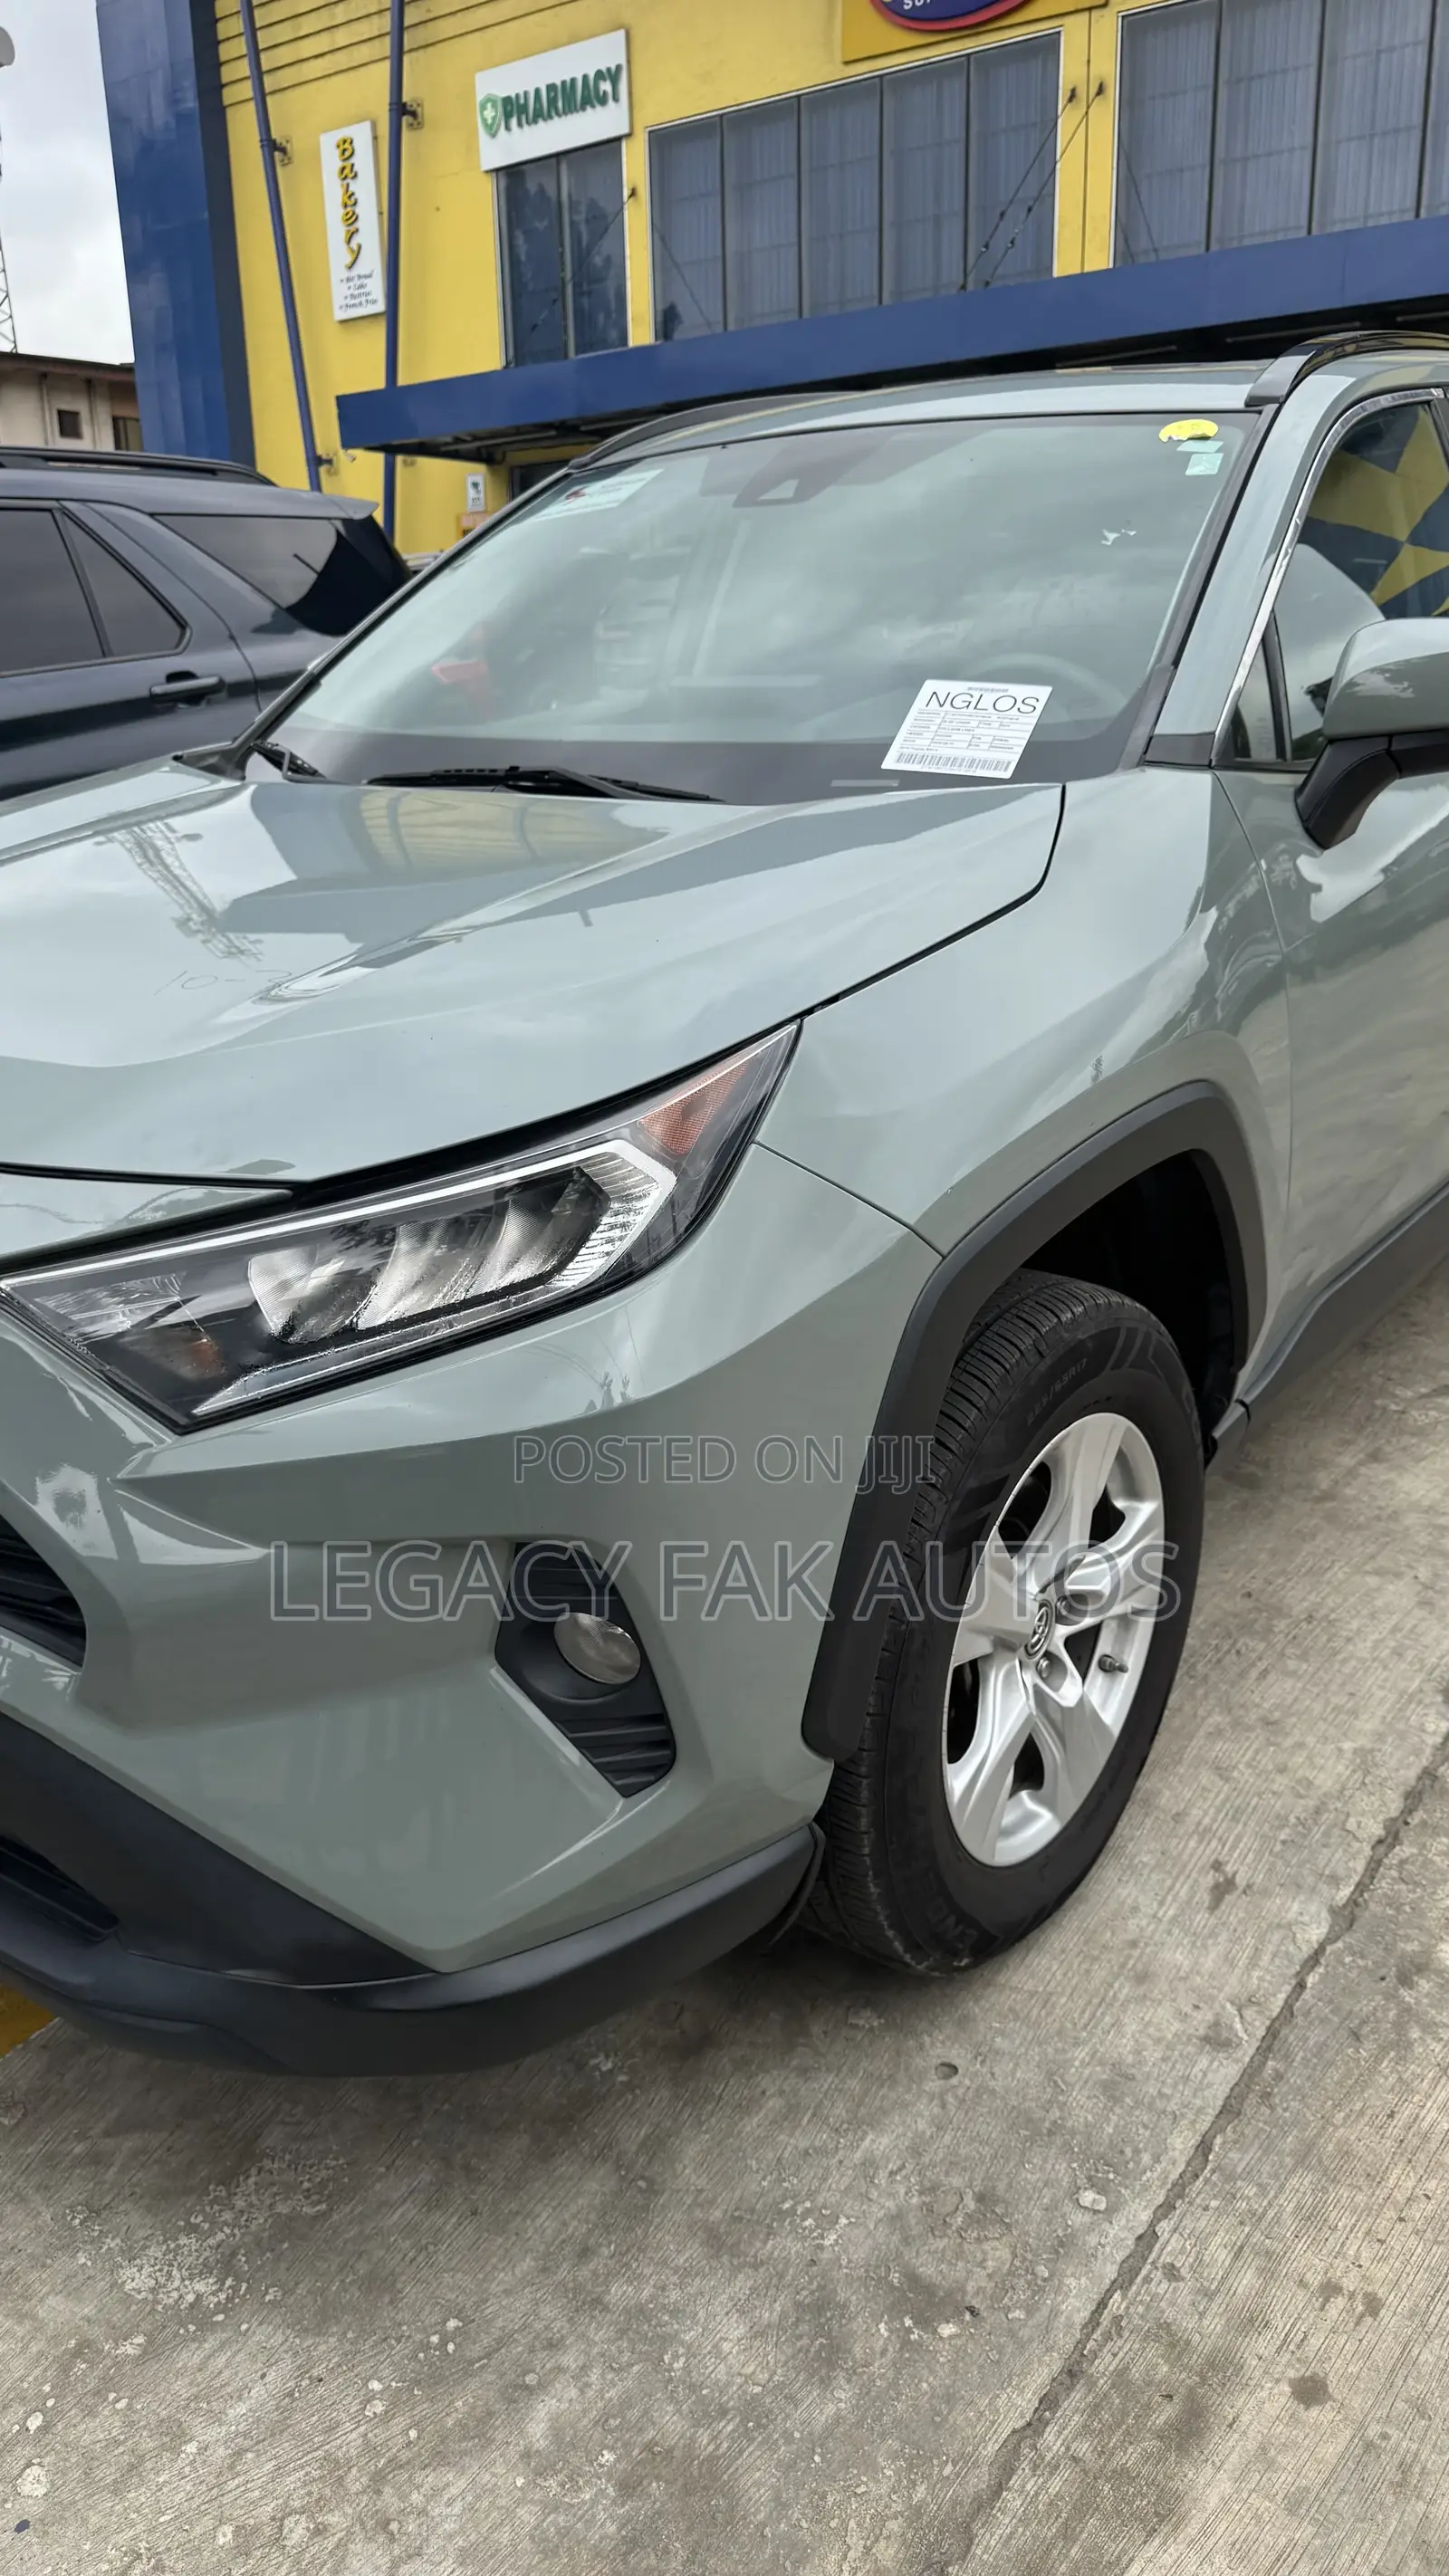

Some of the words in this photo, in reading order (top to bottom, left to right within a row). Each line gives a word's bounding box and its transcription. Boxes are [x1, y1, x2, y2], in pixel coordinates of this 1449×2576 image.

[903, 0, 931, 10] SU
[502, 63, 622, 131] PHARMACY
[336, 136, 361, 271] Bakery
[925, 691, 1040, 714] NGLOS
